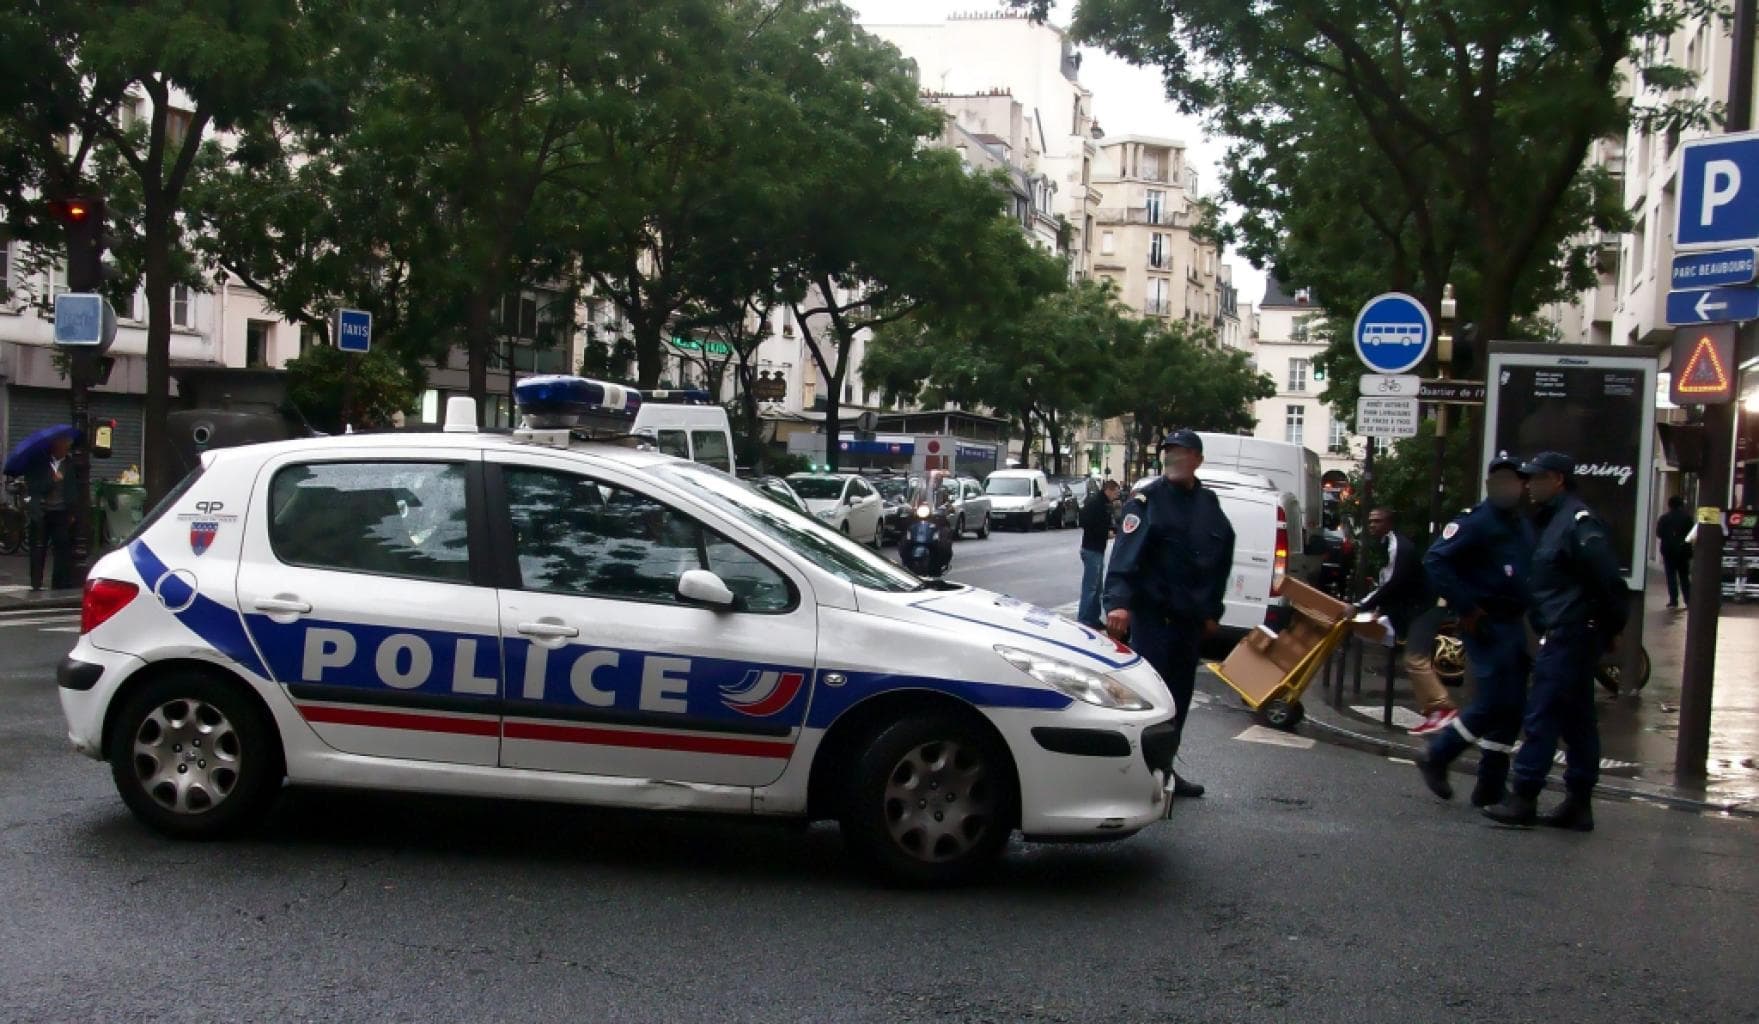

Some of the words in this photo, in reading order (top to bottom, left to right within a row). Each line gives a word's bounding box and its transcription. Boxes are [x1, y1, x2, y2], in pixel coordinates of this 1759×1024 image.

[1700, 159, 1741, 226] P
[1673, 265, 1697, 279] PARC
[1699, 258, 1753, 276] BEAUBOURG
[343, 322, 369, 338] TAXIS
[1459, 387, 1471, 398] de
[301, 626, 692, 714] POLICE
